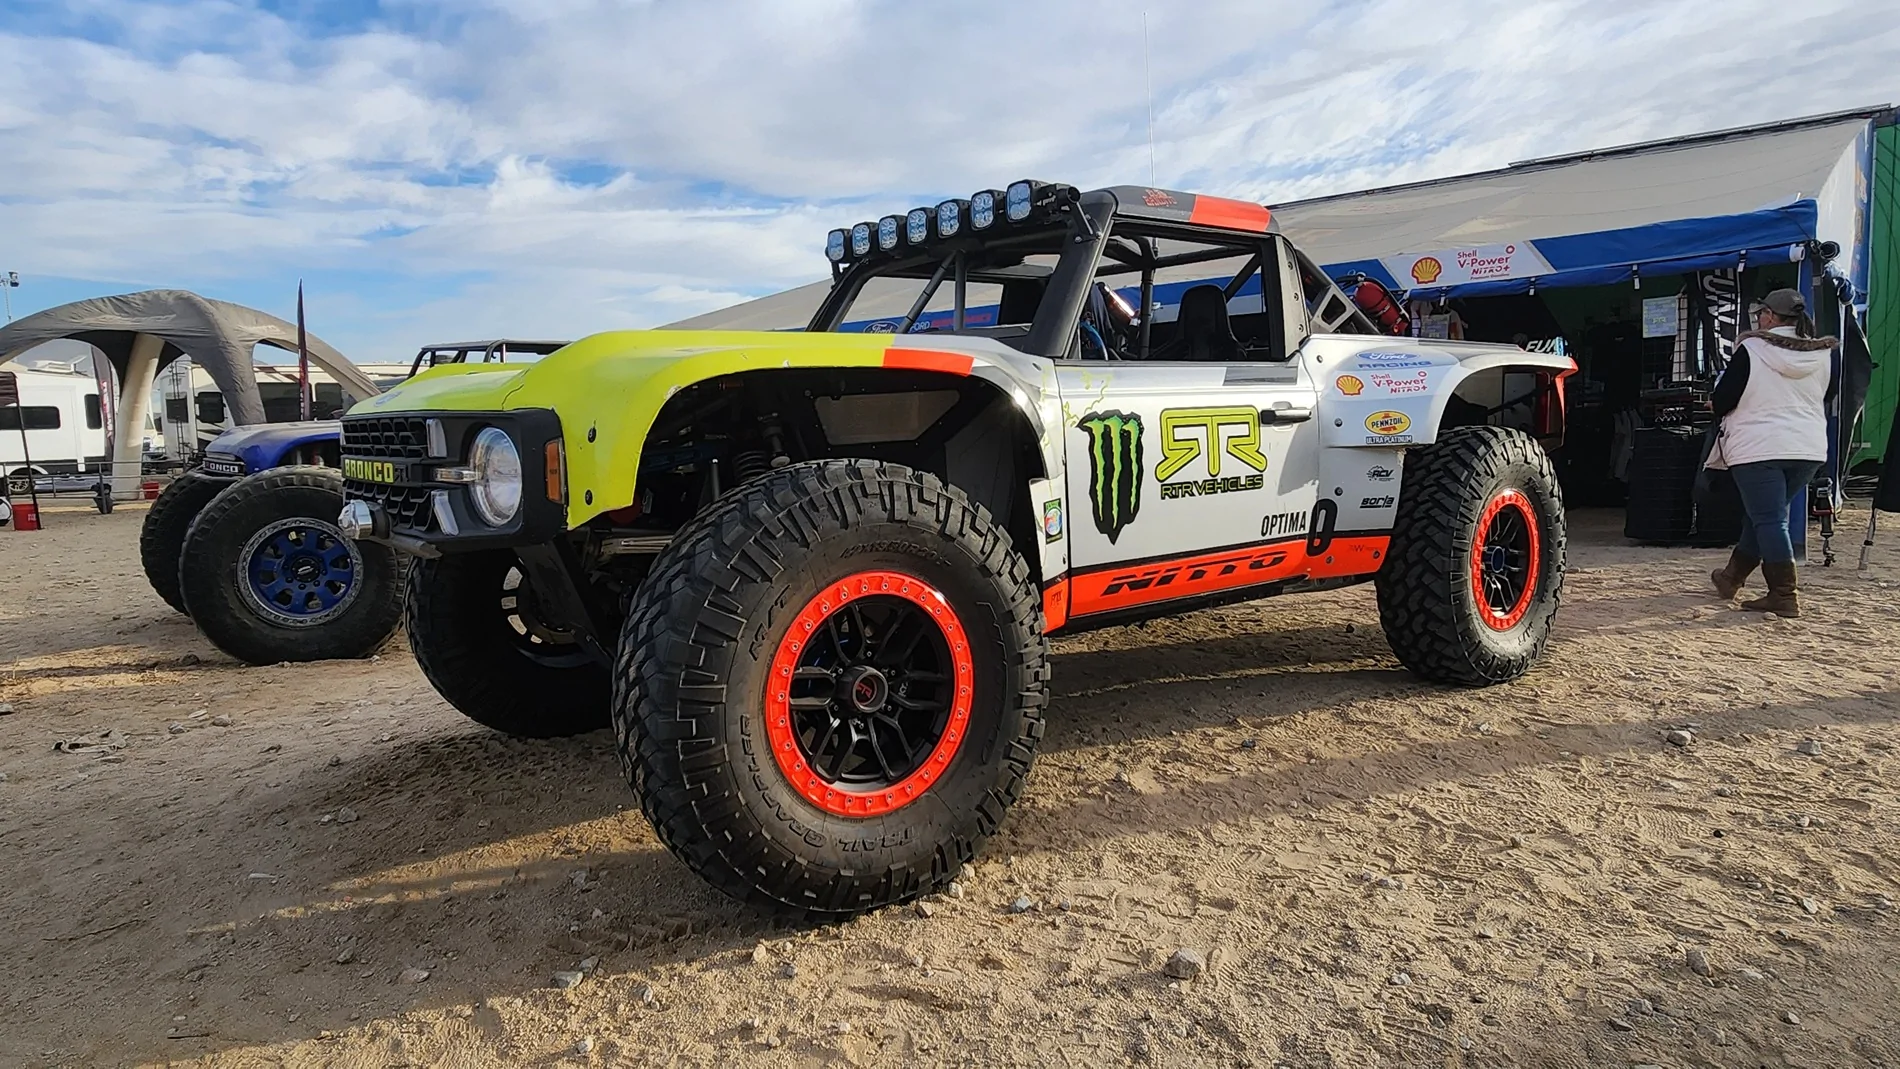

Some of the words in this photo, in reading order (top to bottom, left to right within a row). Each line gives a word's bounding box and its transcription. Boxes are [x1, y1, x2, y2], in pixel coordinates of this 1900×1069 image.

[1457, 250, 1477, 259] Shell
[1458, 256, 1511, 268] V-Power
[1369, 352, 1408, 360] Ford
[1358, 360, 1432, 368] RACING
[1372, 378, 1426, 388] V-Power
[1371, 417, 1403, 428] PENNZOIL
[1366, 436, 1384, 445] ULTRA
[1384, 435, 1412, 444] PLATINUM
[344, 458, 394, 483] BRONCO
[1371, 469, 1395, 478] RCV
[1161, 481, 1195, 500] RTR
[1193, 474, 1264, 496] VEHICLES
[1260, 510, 1306, 537] OPTIMA
[739, 713, 828, 849] GRAPPLER
